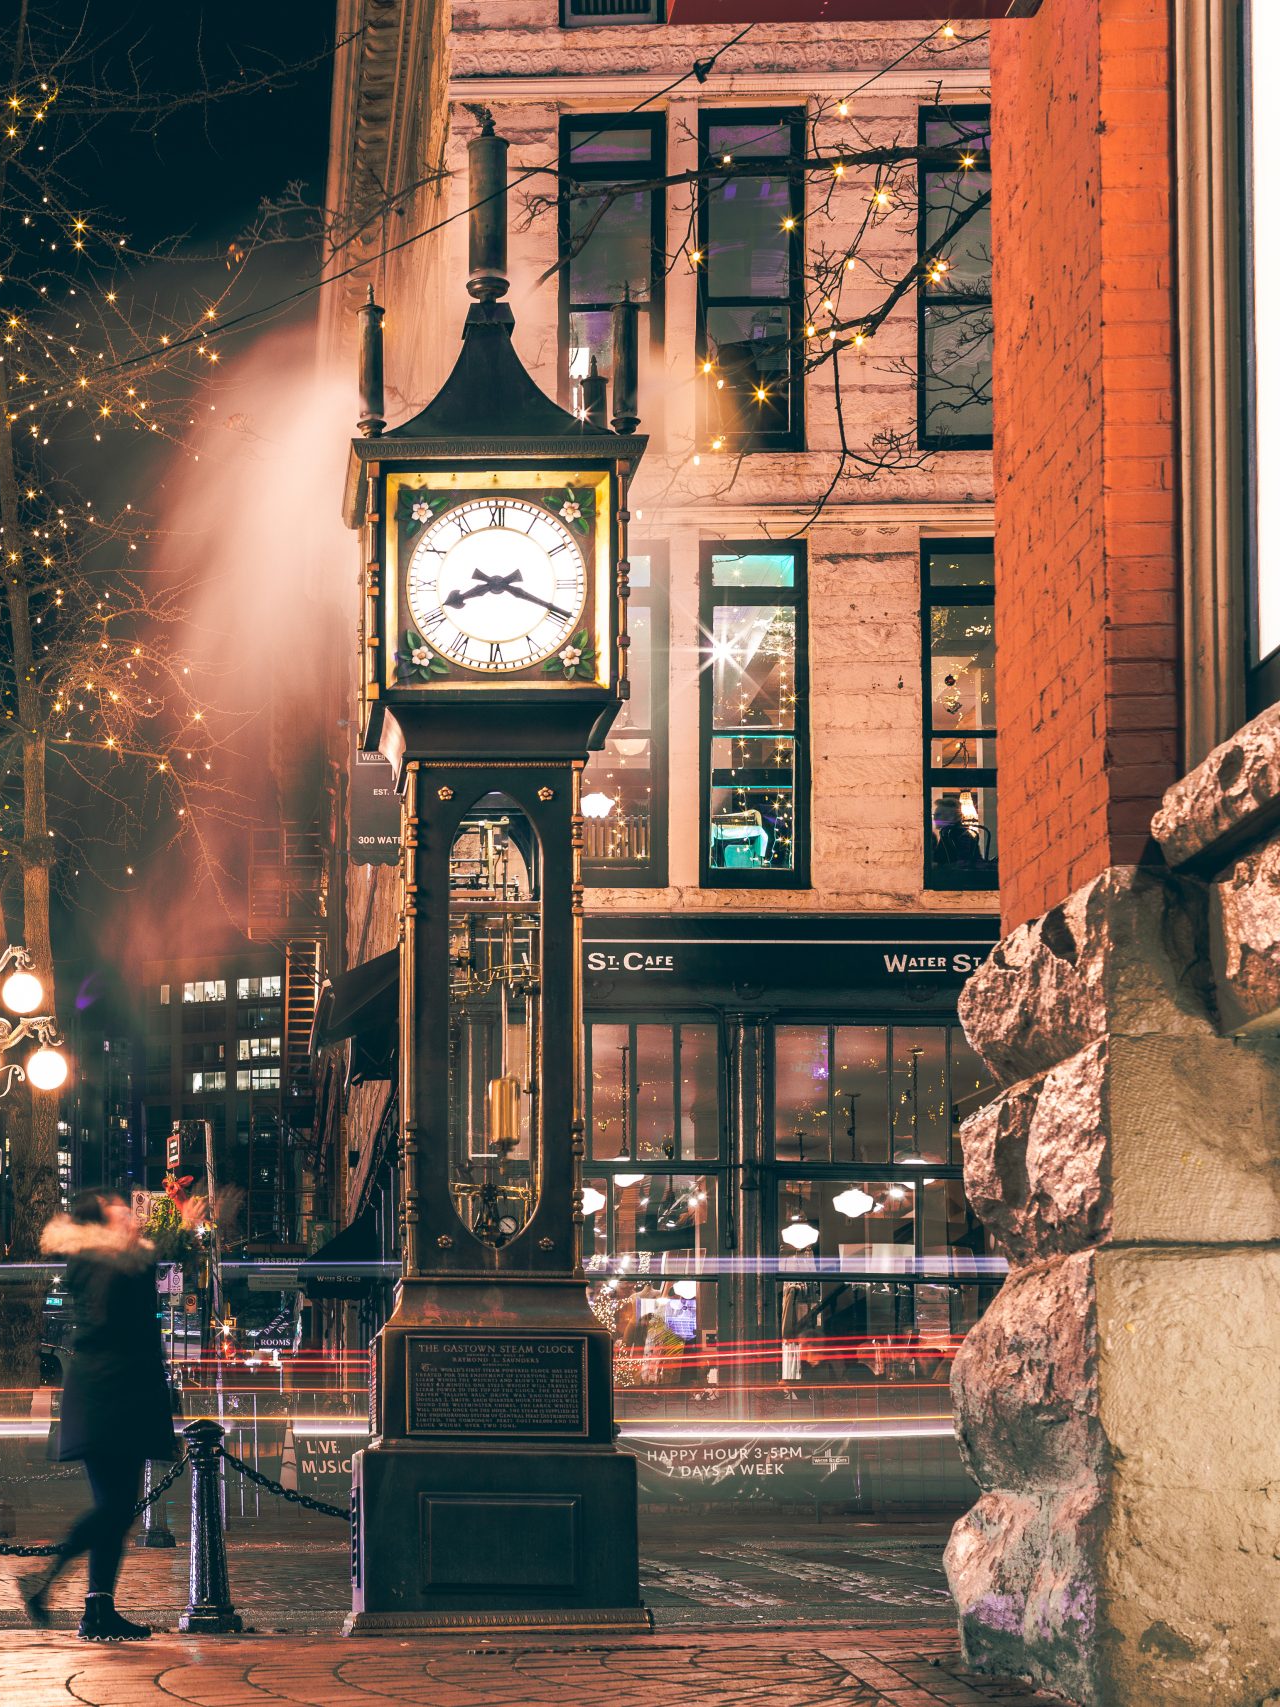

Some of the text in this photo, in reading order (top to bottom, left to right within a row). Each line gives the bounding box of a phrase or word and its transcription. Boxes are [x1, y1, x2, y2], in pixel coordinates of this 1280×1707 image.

[358, 836, 374, 844] 300
[258, 1257, 308, 1265] BASEMEN
[264, 1309, 291, 1335] DANNY'S
[276, 1322, 290, 1334] INN
[260, 1338, 291, 1346] ROOMS
[418, 1344, 574, 1354] THE GASTOWN STEAM CLOCK
[306, 1440, 337, 1454] LIVE
[647, 1446, 802, 1462] HAPPY HOUR 3-5PM
[302, 1460, 352, 1474] MUSIC
[666, 1464, 784, 1478] 7 DAYS A WEEK
